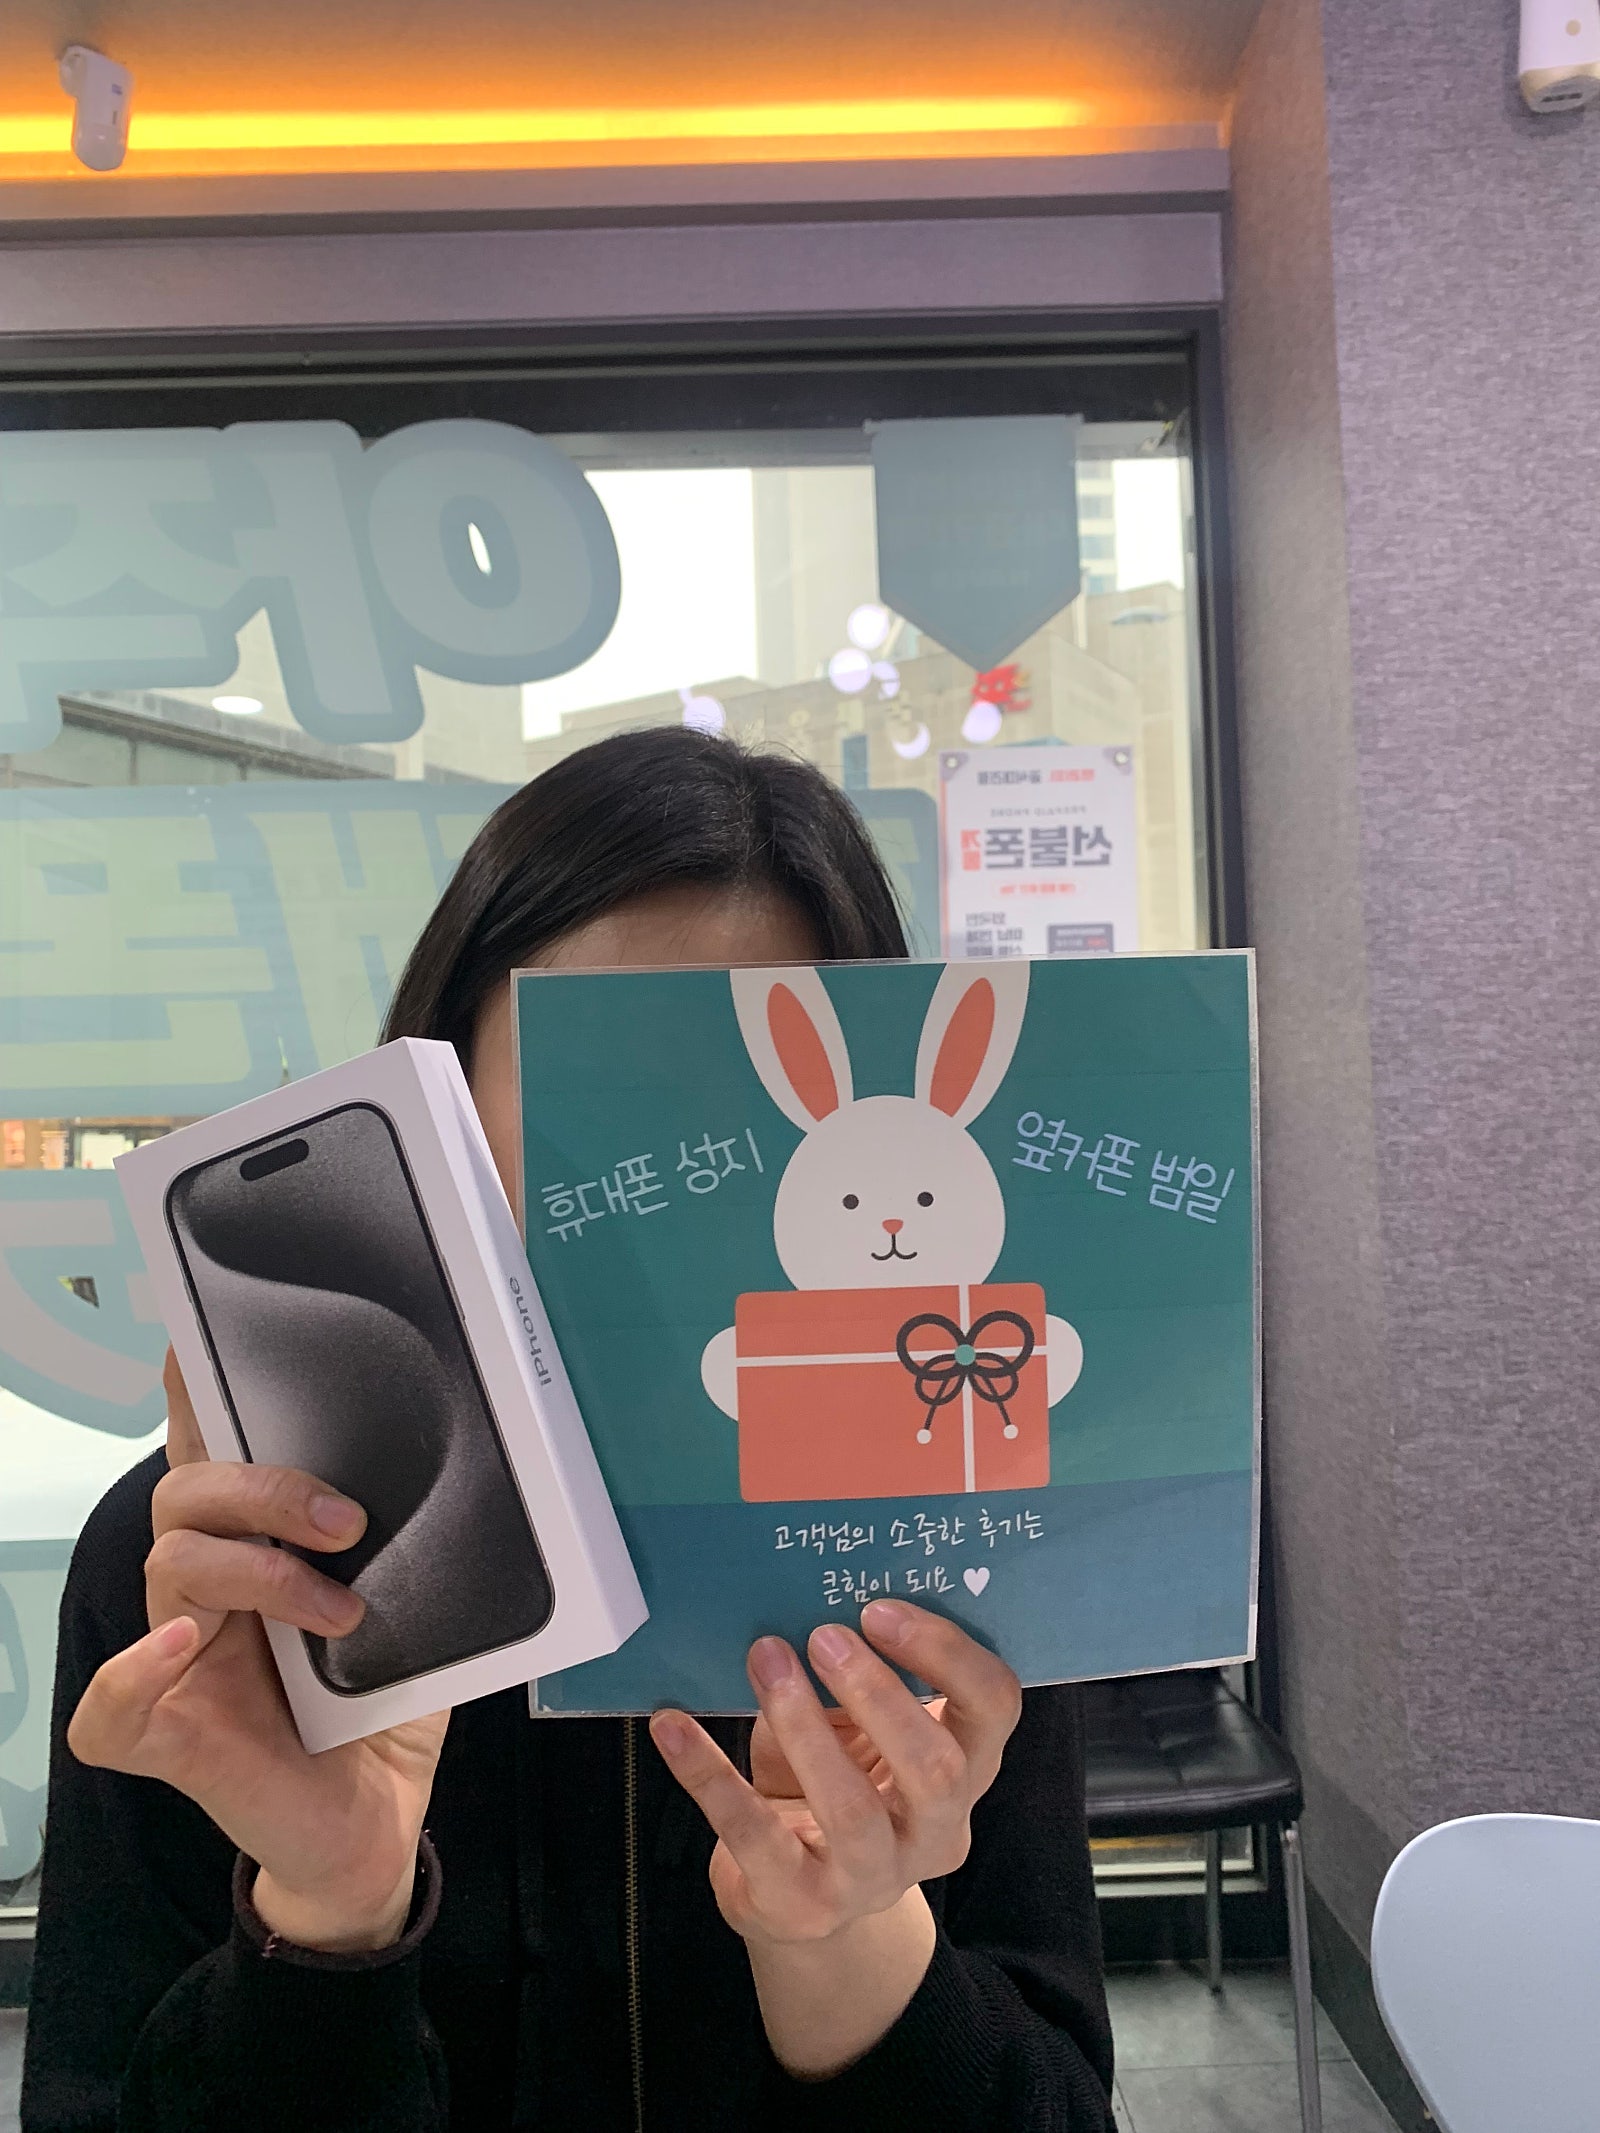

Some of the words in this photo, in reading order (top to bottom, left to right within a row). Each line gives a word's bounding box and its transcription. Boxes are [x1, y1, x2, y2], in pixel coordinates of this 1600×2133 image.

[541, 1153, 669, 1243] 휴대폰
[676, 1127, 765, 1195] 성지
[1011, 1111, 1141, 1197] 옆커폰
[1149, 1150, 1235, 1224] 범일
[509, 1276, 552, 1386] iPhone
[774, 1521, 874, 1556] 고객님의
[890, 1513, 966, 1556] 소중한
[978, 1508, 1044, 1548] 후기는
[822, 1570, 890, 1606] 큰힘이
[905, 1566, 955, 1594] 되요
